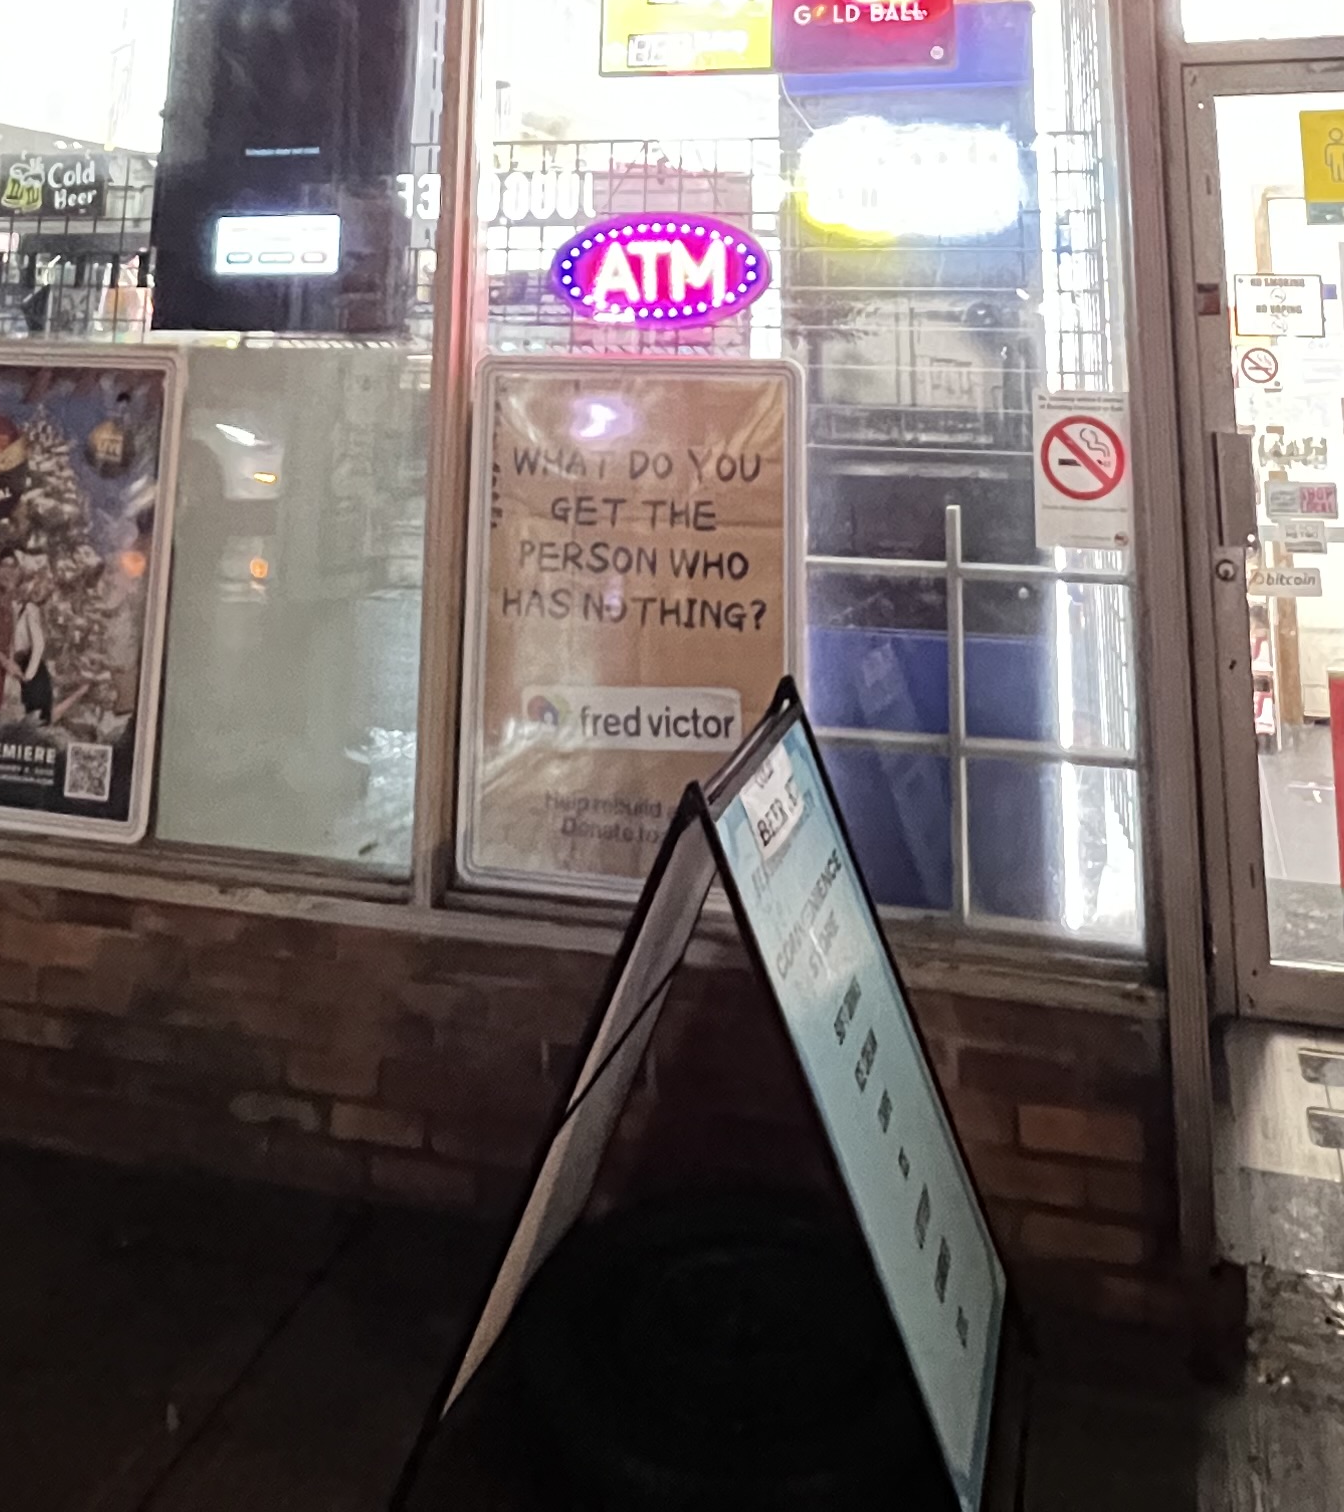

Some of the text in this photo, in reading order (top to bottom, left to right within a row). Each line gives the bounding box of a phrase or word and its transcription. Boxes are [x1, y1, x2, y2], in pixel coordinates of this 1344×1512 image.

[47, 160, 97, 188] Cold
[53, 189, 97, 210] Beer
[592, 238, 726, 308] ATM
[513, 446, 761, 483] WHAT DO YOU
[551, 494, 717, 532] GET THE
[519, 539, 750, 580] PERSON WHO
[1266, 573, 1316, 586] bitcoin
[502, 589, 768, 632] HAS NOTHING?
[580, 704, 735, 739] fred victor
